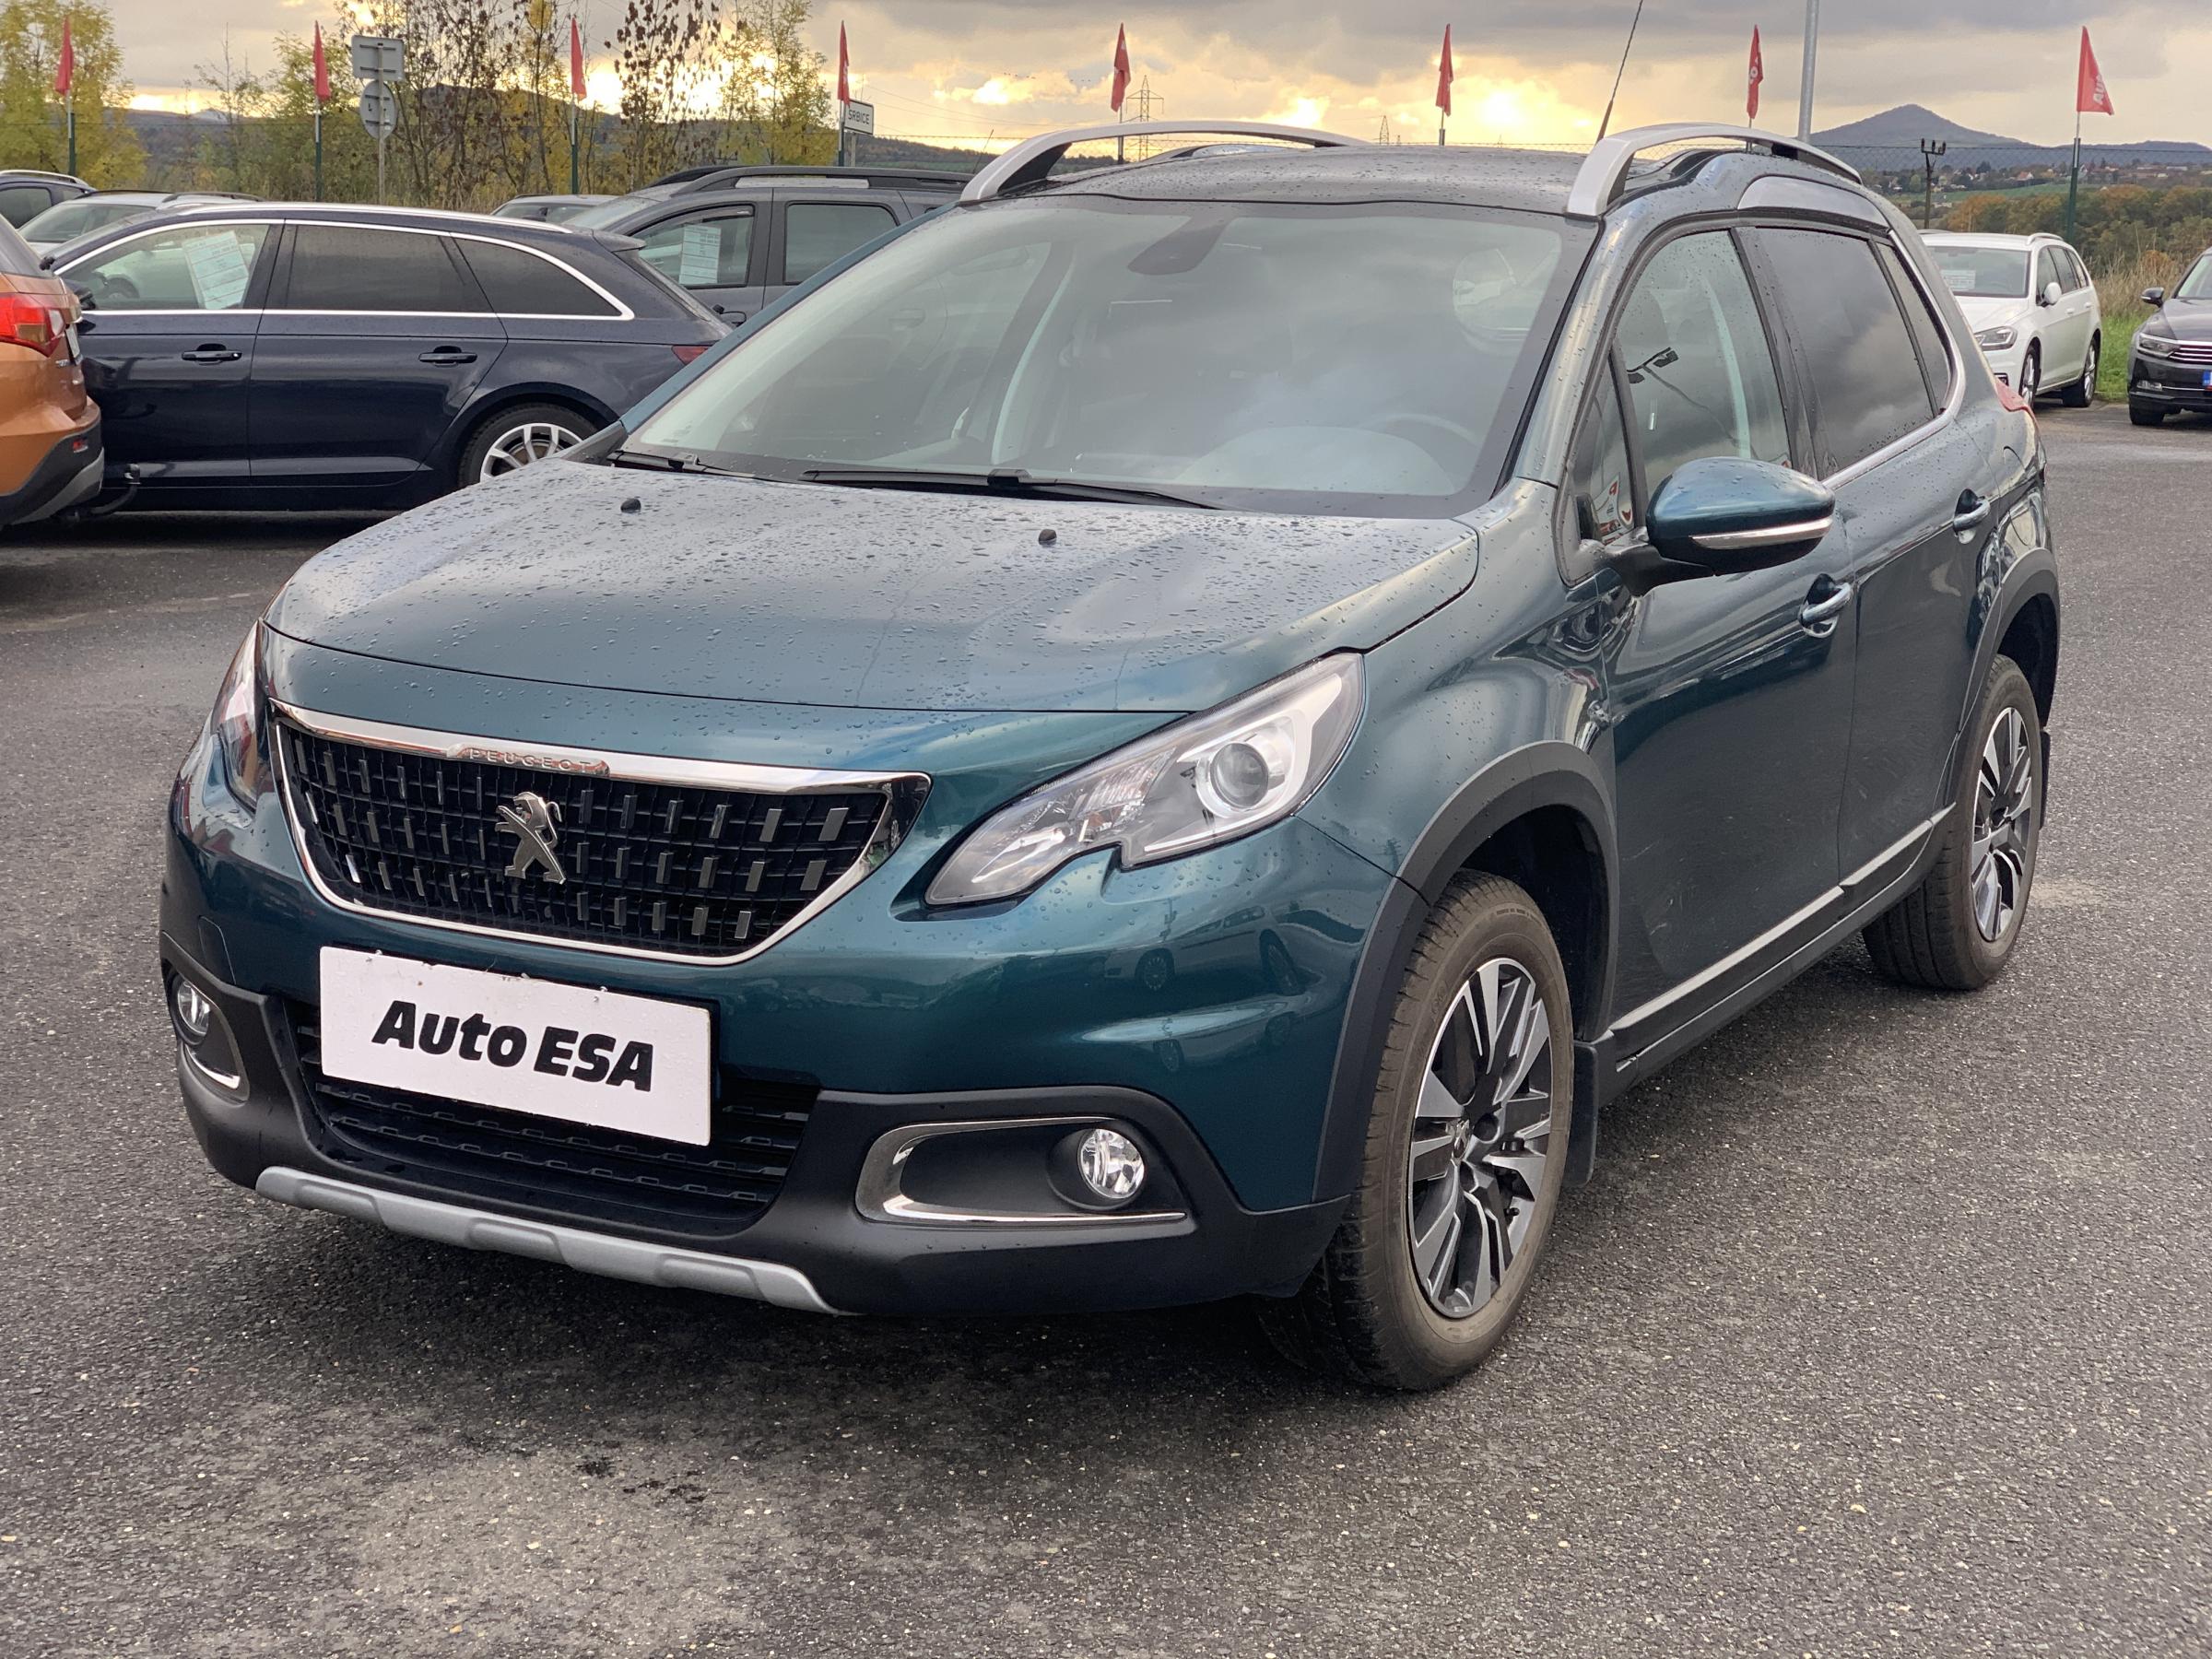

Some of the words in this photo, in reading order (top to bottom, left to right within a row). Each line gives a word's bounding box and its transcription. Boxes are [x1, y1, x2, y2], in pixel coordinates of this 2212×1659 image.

[848, 110, 870, 125] SRBICE
[468, 747, 592, 773] PEUGEOT
[371, 1000, 527, 1067] Auto
[533, 1026, 654, 1092] ESA
